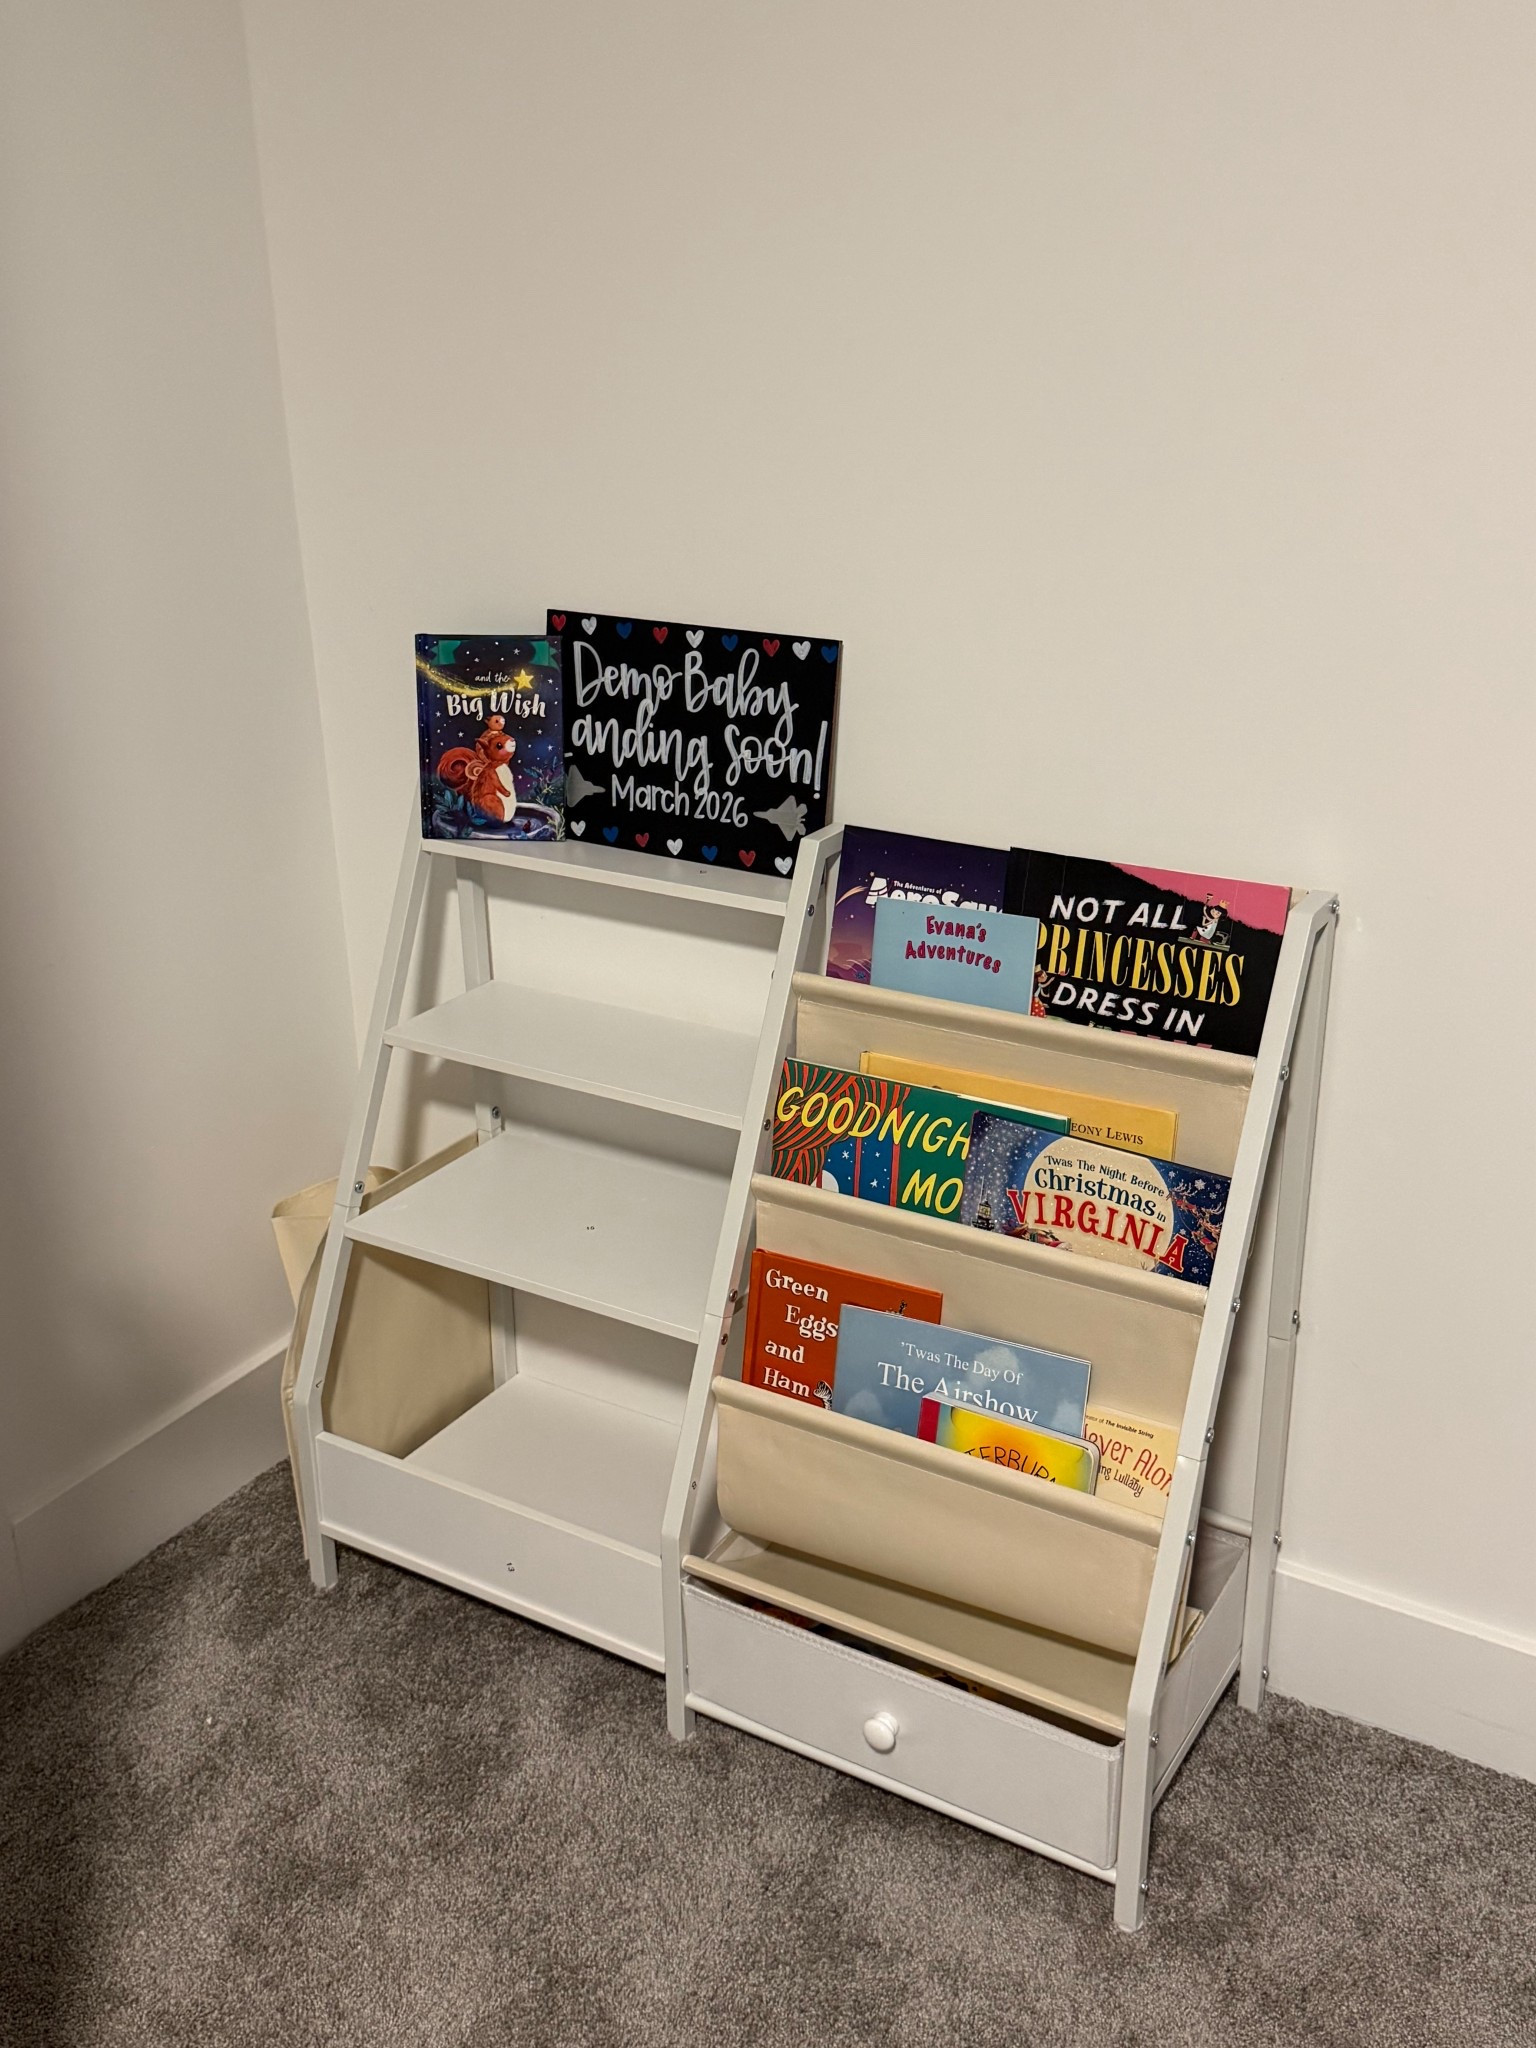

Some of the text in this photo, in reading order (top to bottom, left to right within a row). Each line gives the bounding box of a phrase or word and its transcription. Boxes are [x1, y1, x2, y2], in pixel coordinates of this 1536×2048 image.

[475, 671, 511, 683] and the
[573, 641, 799, 748] Demo Baby
[446, 687, 546, 721] Big Wish
[564, 698, 828, 800] anding Soon!
[611, 773, 749, 828] March 2026
[893, 880, 904, 889] The
[905, 882, 935, 894] Adventures
[926, 915, 987, 942] Evana's
[1049, 894, 1187, 931] NOT ALL
[905, 940, 1002, 974] Adventures
[1051, 981, 1206, 1037] DRESS IN
[776, 1086, 972, 1161] GOODNIGH
[1070, 1122, 1103, 1137] EONY
[901, 1168, 964, 1214] MO
[1034, 1167, 1167, 1223] Christmas in
[1043, 1154, 1165, 1198] 'Twas The Night Before
[1006, 1188, 1189, 1273] VIRGINIA
[765, 1268, 829, 1303] Green
[784, 1303, 839, 1342] Eggs
[764, 1339, 805, 1364] and
[901, 1341, 1024, 1385] 'Twas The Day Of
[763, 1366, 811, 1398] Ham
[877, 1361, 1039, 1423] The Airshow
[1113, 1469, 1144, 1498] Lullaby
